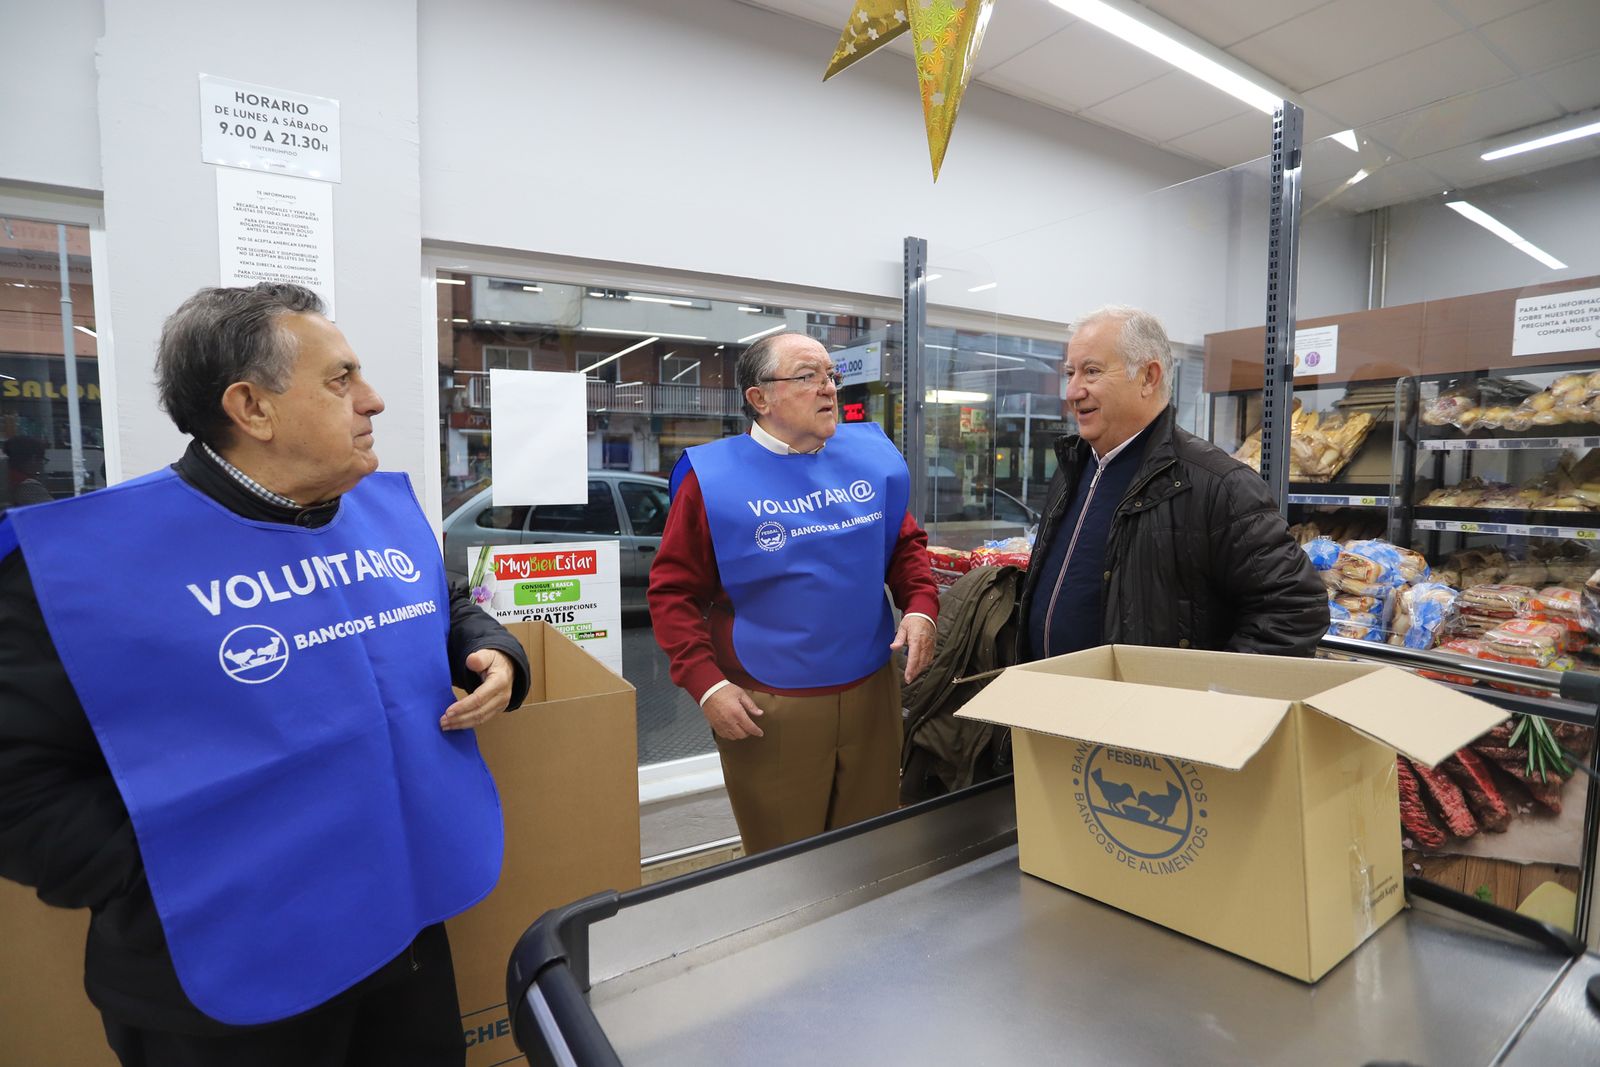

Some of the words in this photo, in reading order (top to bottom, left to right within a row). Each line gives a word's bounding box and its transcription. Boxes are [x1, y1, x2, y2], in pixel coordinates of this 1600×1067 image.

[235, 91, 309, 115] HORARIO
[214, 105, 229, 116] DE
[233, 108, 268, 123] LUNES
[271, 116, 280, 125] A
[282, 117, 328, 133] SÁBADO
[219, 121, 257, 140] 9.00
[263, 130, 275, 143] A
[263, 191, 296, 199] INFORMAMOS
[1518, 314, 1542, 322] SOBRE
[1545, 308, 1586, 318] NUESTROS
[1521, 320, 1560, 329] PREGUNTA
[747, 479, 876, 517] VOLUNTARI@
[790, 524, 828, 538] BANCOS
[827, 522, 840, 531] DE
[841, 511, 883, 529] ALIMENTOS
[379, 600, 437, 626] ALIMENTOS
[497, 609, 511, 618] HAY
[513, 608, 535, 616] MILES
[546, 603, 597, 613] SUSCRIPCIONES
[1107, 748, 1162, 771] FESBAL
[1074, 791, 1115, 854] BANCOS
[1116, 850, 1137, 869] DE
[1139, 825, 1208, 875] ALIMENTOS
